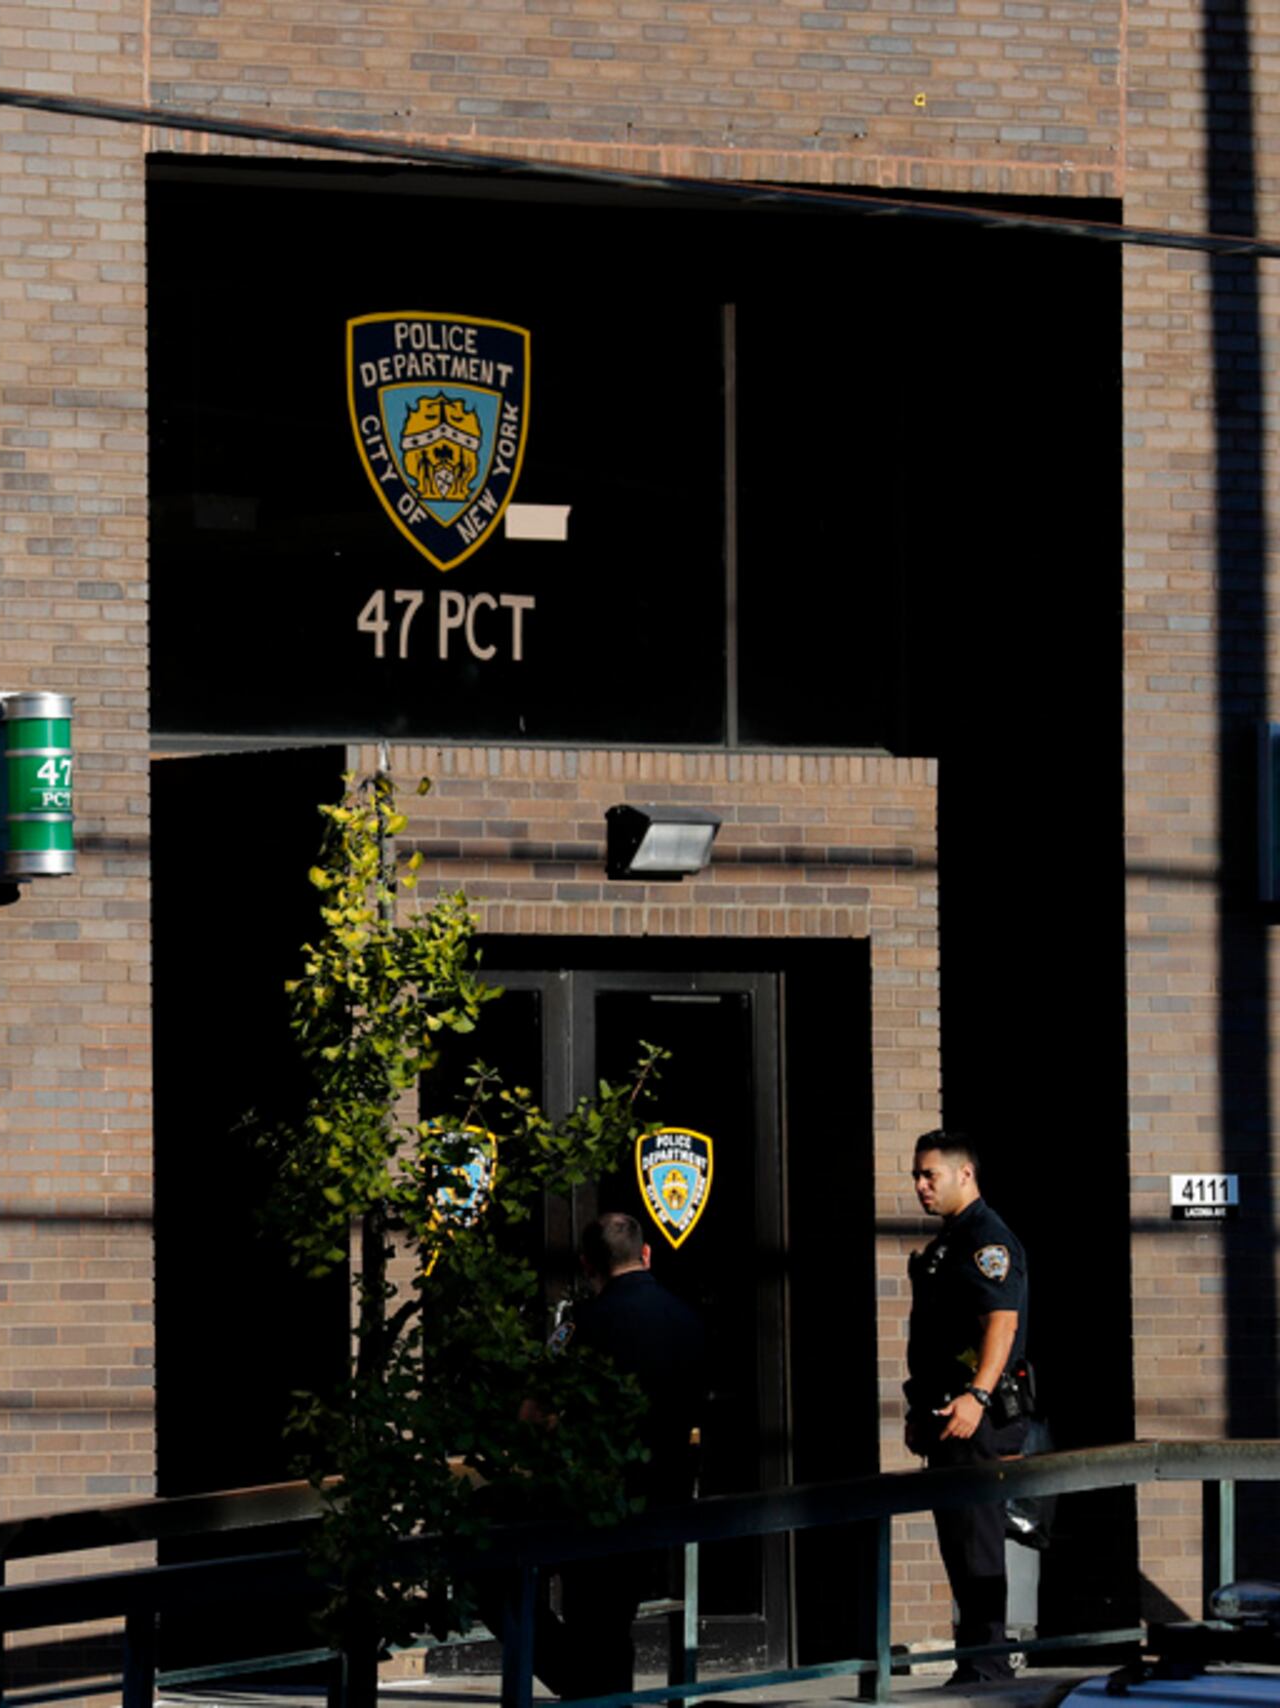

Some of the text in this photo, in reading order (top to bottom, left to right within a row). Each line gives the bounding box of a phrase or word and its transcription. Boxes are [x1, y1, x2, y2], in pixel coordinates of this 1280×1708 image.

[394, 322, 478, 354] POLICE
[360, 352, 514, 388] DEPARTMENT
[361, 415, 427, 525] CITY OF
[456, 401, 519, 544] NEW YORK
[357, 589, 535, 661] 47 PCT
[36, 758, 72, 787] 47
[655, 1134, 692, 1150] POLICE
[1182, 1178, 1228, 1202] 4111
